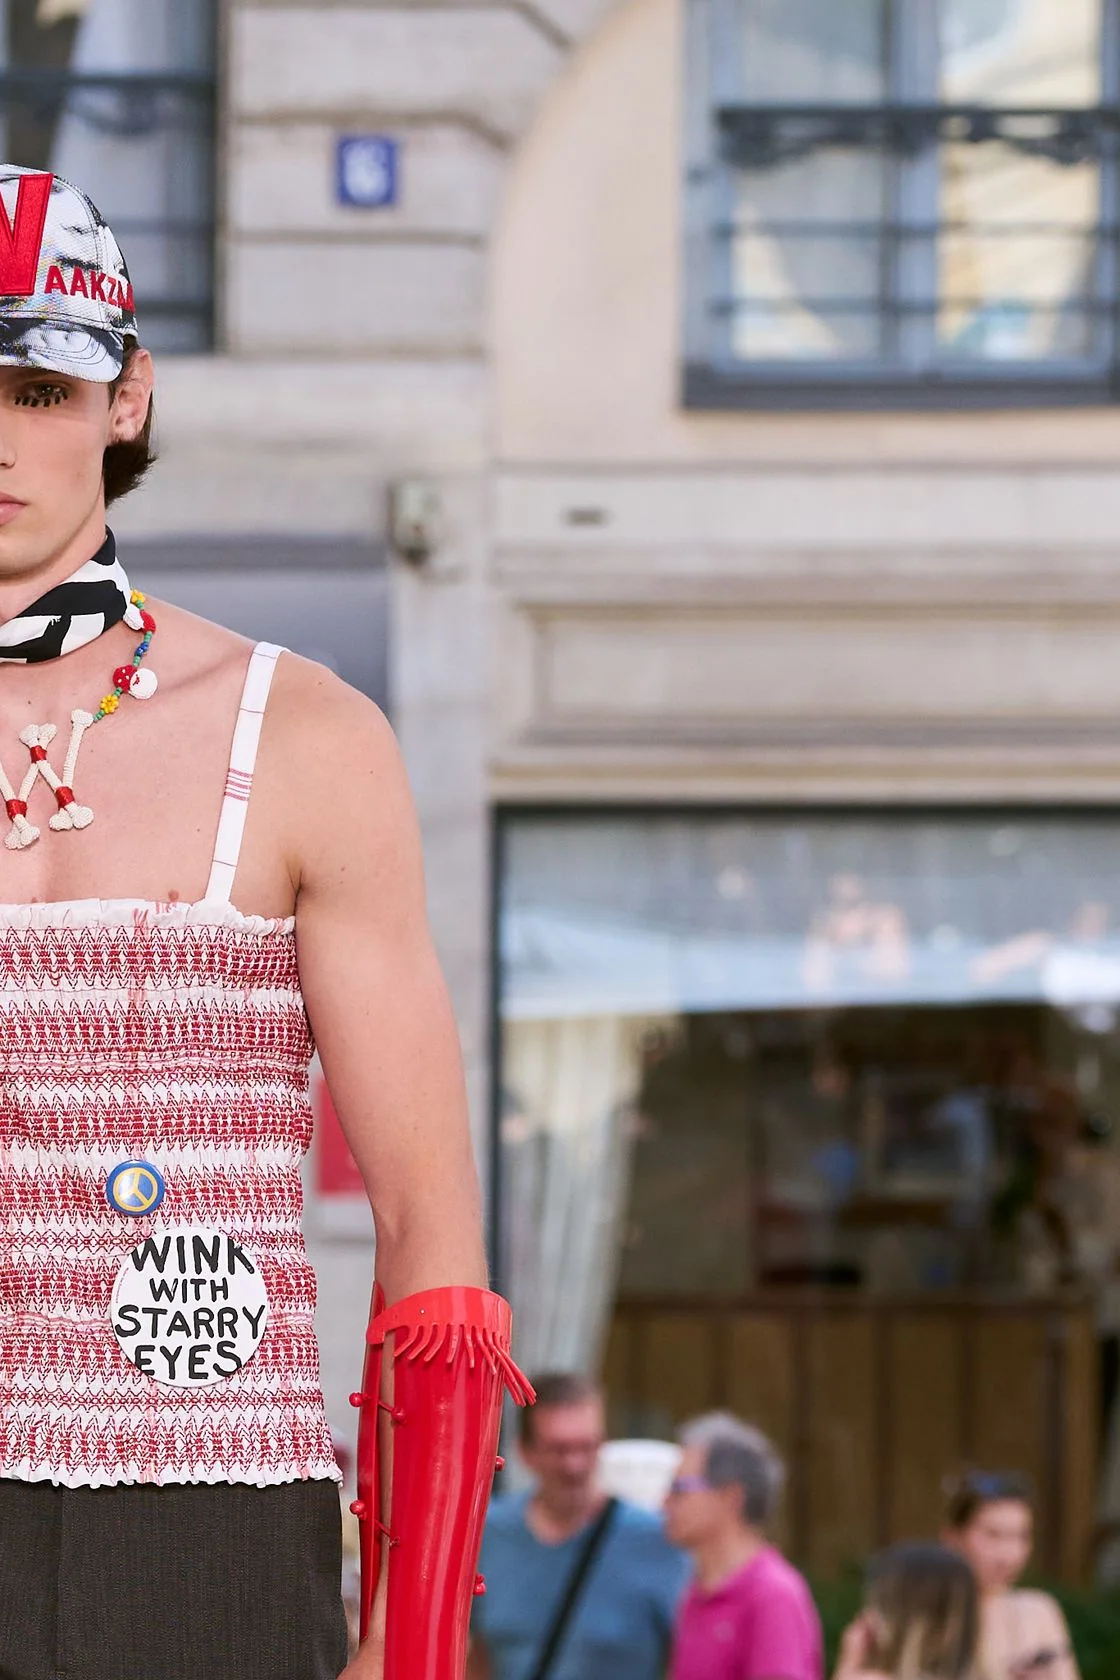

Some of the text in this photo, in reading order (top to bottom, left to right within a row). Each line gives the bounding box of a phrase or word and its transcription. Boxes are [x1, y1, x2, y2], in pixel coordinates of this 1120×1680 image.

[130, 1235, 255, 1275] WINK
[149, 1277, 229, 1303] WITH
[114, 1304, 266, 1340] STARRY
[134, 1340, 243, 1380] EYES
